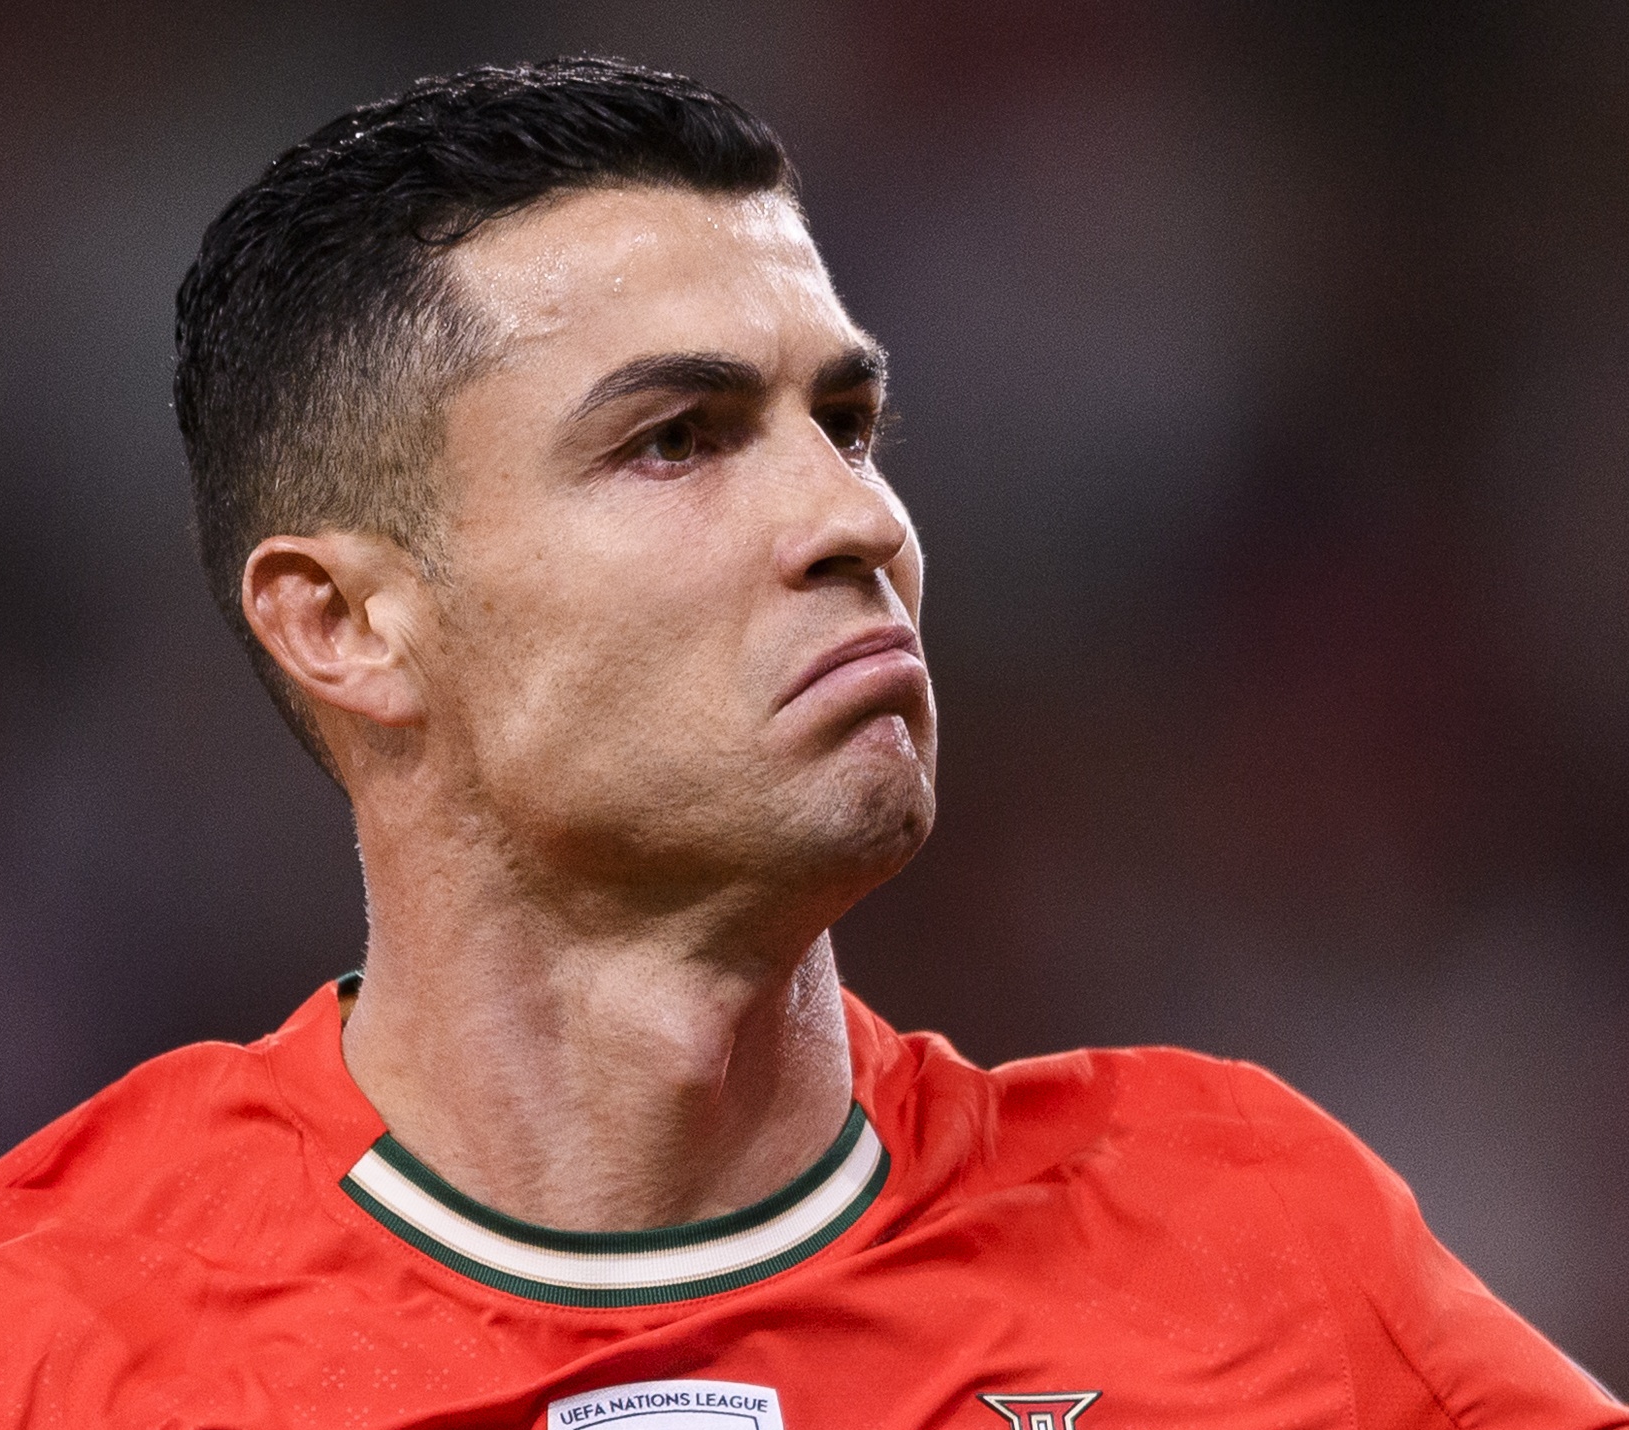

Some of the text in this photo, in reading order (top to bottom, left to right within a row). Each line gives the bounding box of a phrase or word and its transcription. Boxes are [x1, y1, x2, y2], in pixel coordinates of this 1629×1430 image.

[560, 1393, 768, 1425] UEFA NATIONS LEAGUE
